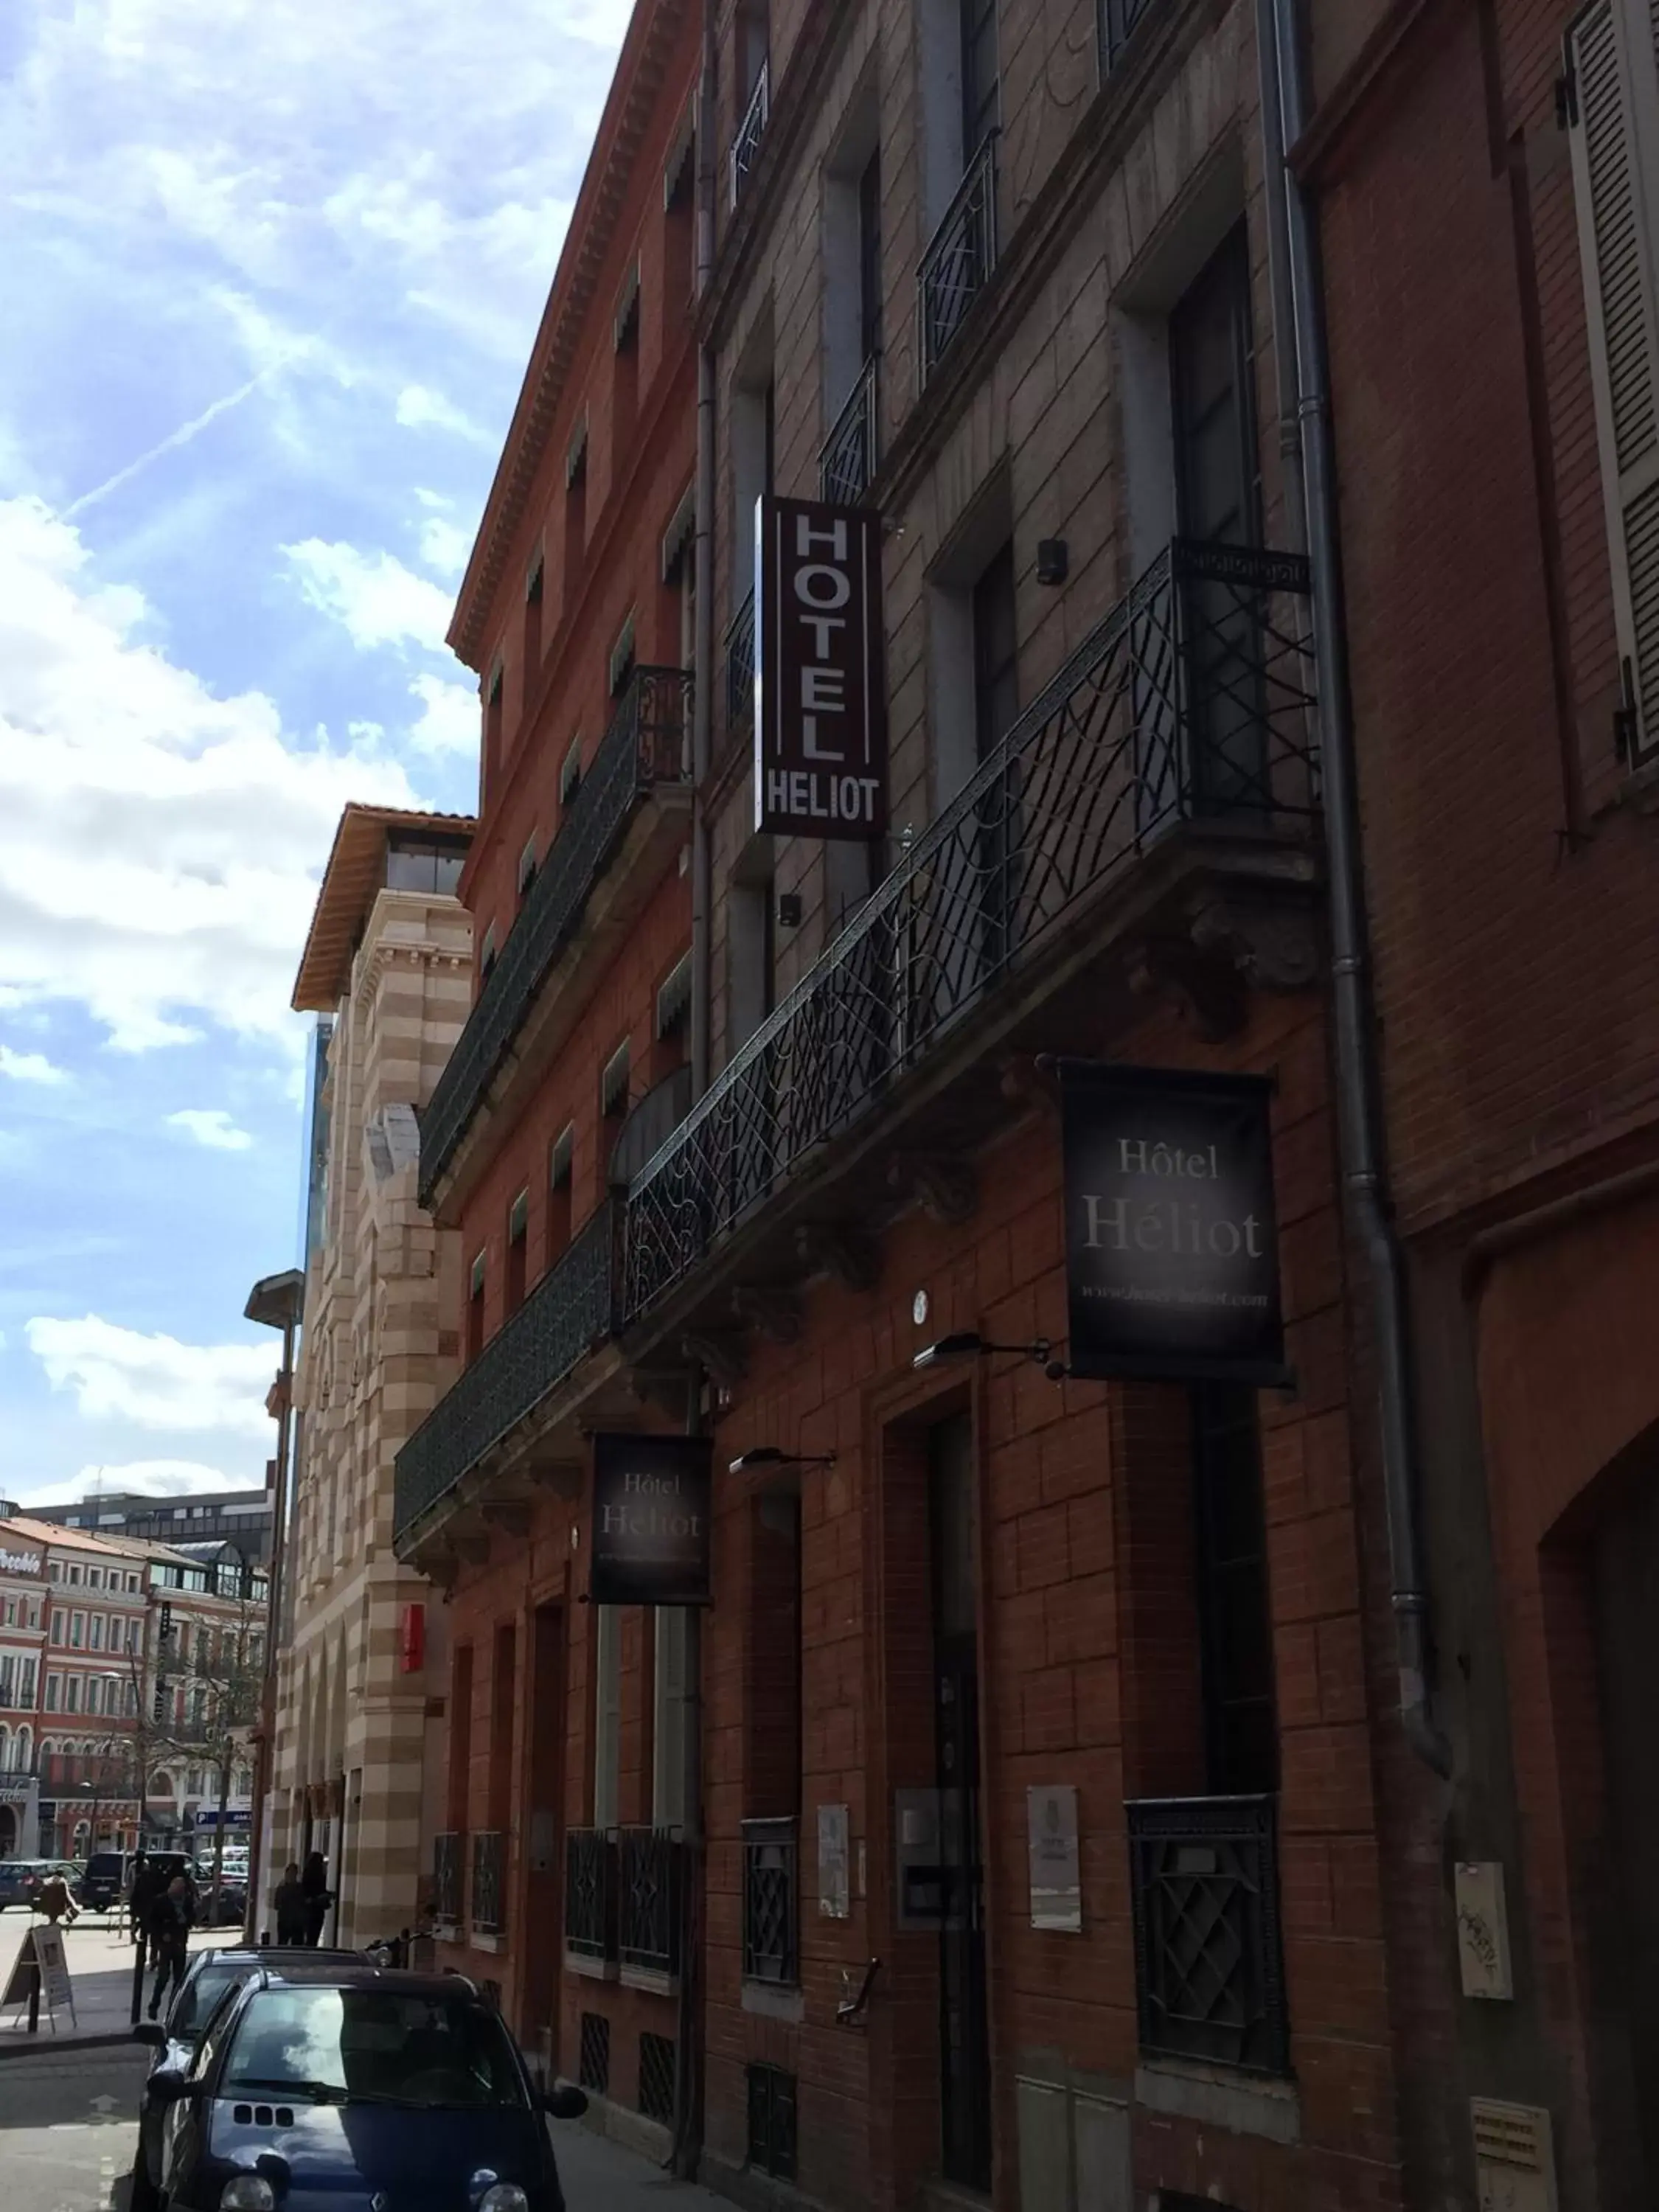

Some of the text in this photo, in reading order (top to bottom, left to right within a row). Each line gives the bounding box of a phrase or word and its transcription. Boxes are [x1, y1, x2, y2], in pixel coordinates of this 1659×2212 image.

[793, 514, 851, 762] HOTEL
[768, 768, 880, 822] HELIOT
[1119, 1138, 1218, 1178] Hôtel
[1082, 1195, 1263, 1258] Héliot
[625, 1473, 680, 1495] Hôtel
